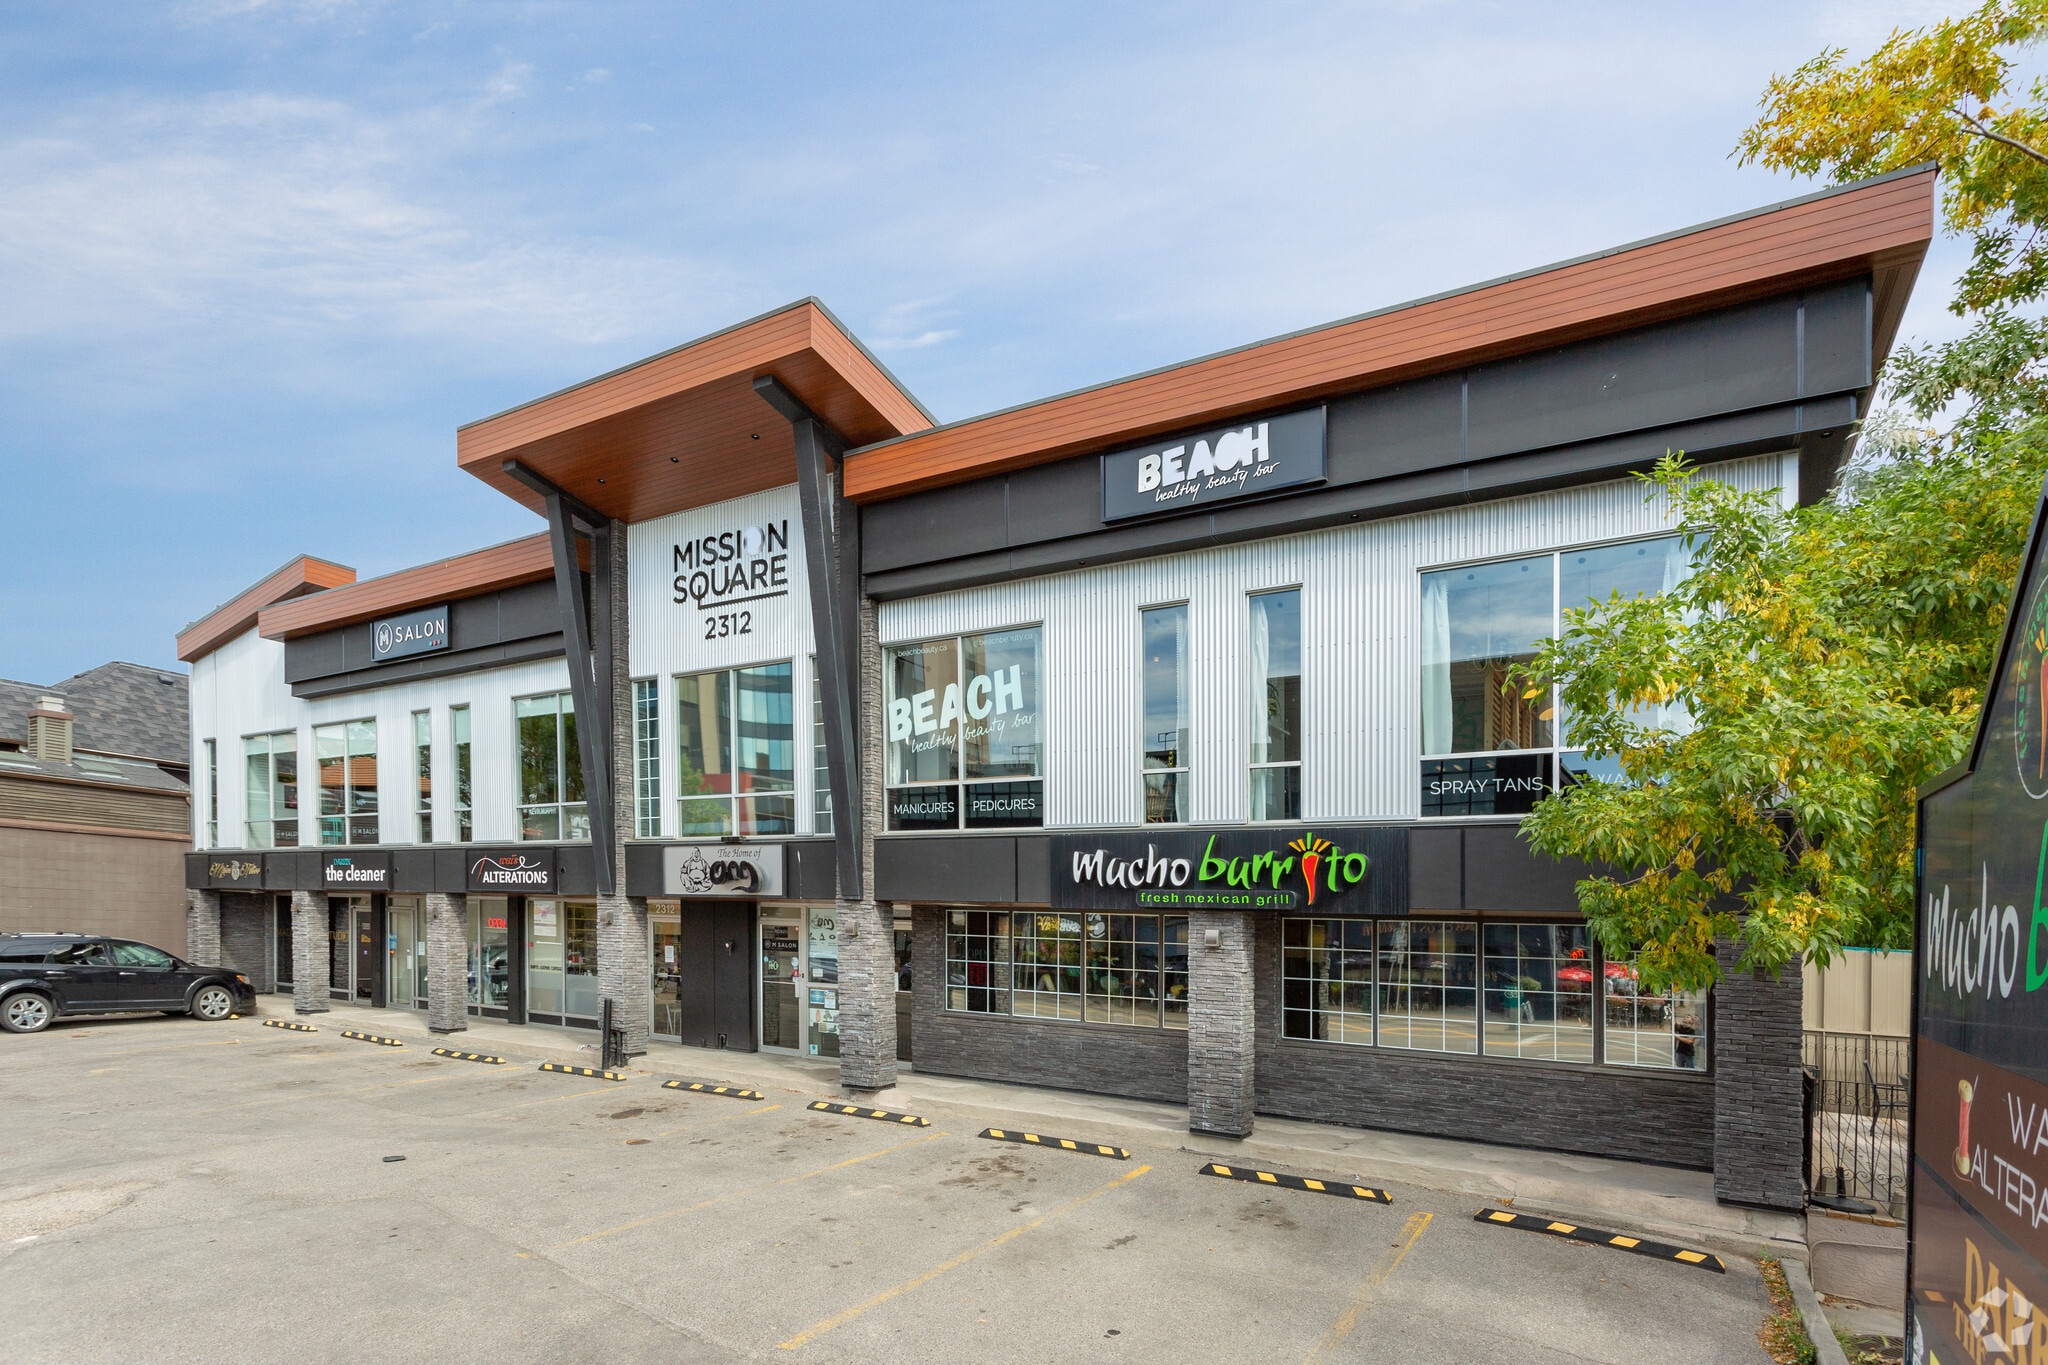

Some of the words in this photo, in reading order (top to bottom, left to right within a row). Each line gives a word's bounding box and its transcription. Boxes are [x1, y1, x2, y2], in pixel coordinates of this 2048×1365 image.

[1155, 479, 1202, 502] healthy
[1205, 468, 1249, 490] beauty
[1253, 461, 1281, 478] bar
[673, 554, 788, 609] SQUARE
[395, 618, 445, 643] SALON
[704, 610, 752, 640] 2312
[888, 664, 1024, 742] BEACH
[911, 731, 958, 754] healthy
[963, 717, 1006, 742] beauty
[1011, 711, 1036, 728] bar
[1430, 779, 1489, 795] SPRAY
[1492, 776, 1544, 793] TANS
[893, 801, 955, 814] MANICURES
[972, 798, 1036, 812] PEDICURES
[717, 848, 730, 858] The
[732, 848, 753, 858] Home
[754, 847, 763, 861] of
[325, 864, 344, 882] the
[345, 864, 386, 882] cleaner
[482, 870, 548, 884] ALTERATIONS
[1140, 892, 1179, 904] fresh
[1184, 892, 1250, 905] mexican
[1256, 894, 1290, 906] grill
[655, 904, 675, 914] 2312
[487, 917, 507, 929] OPEN
